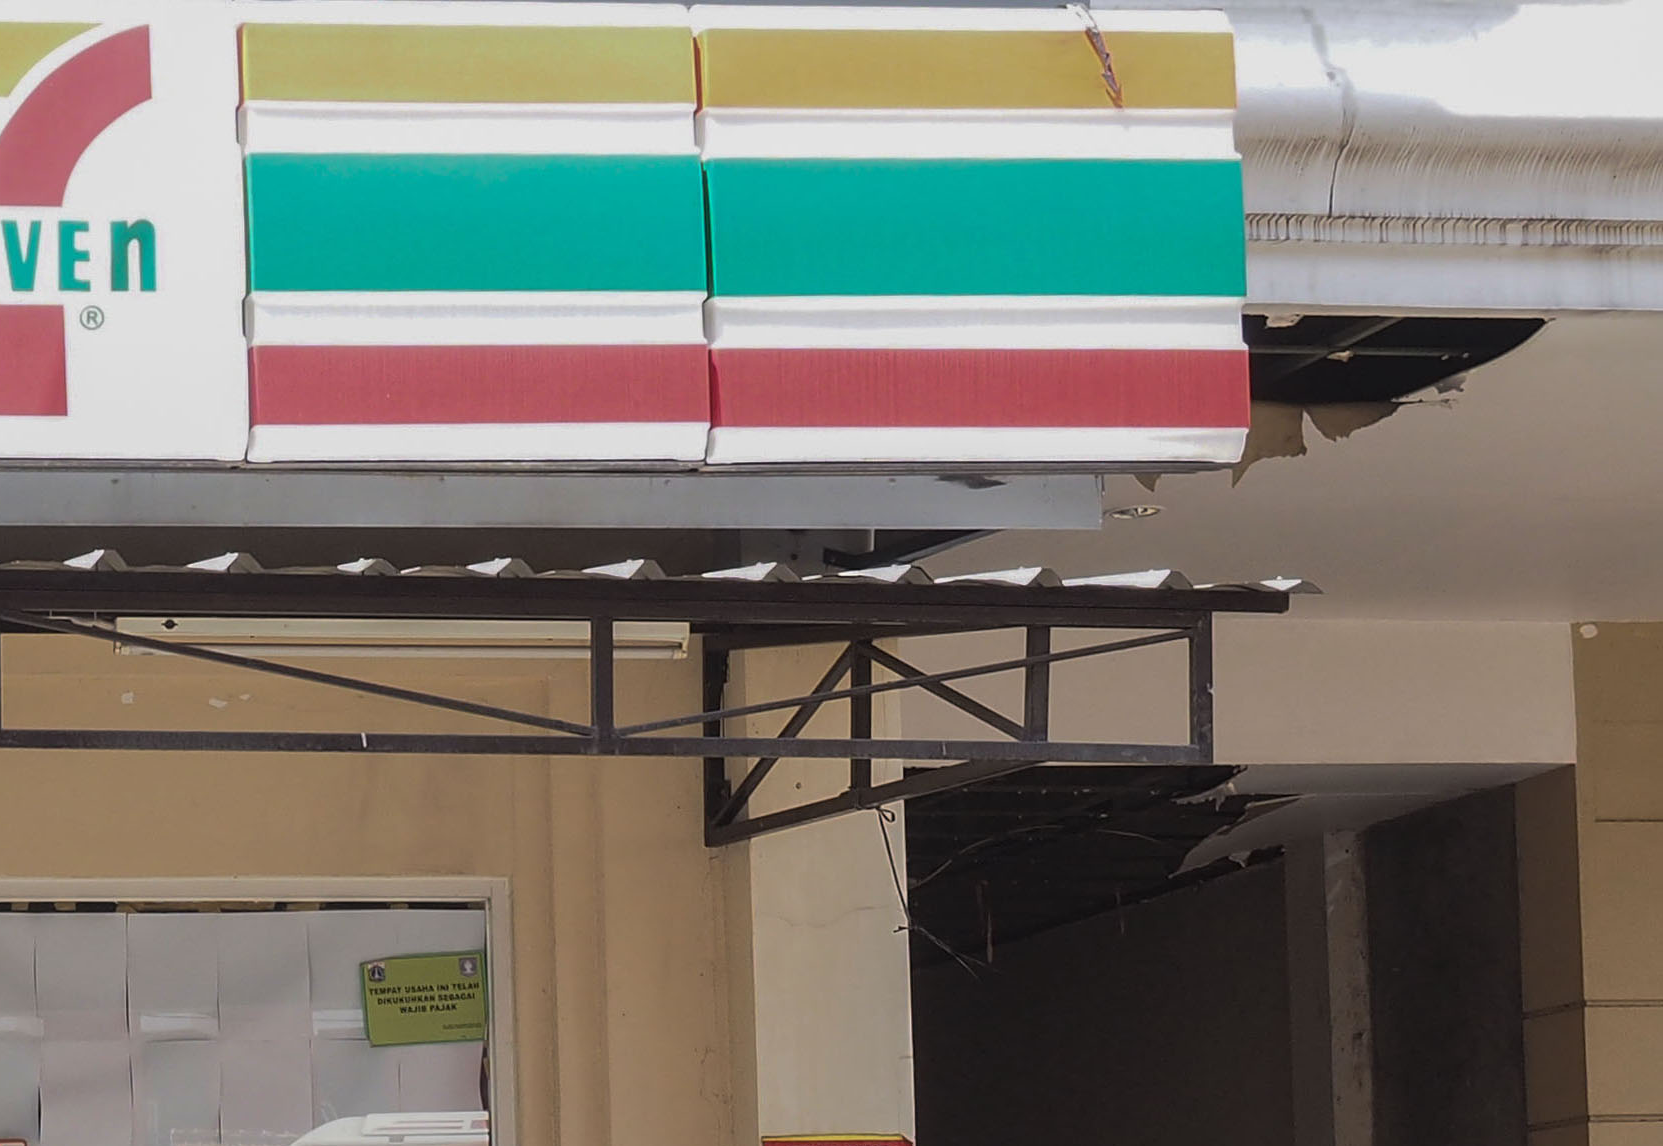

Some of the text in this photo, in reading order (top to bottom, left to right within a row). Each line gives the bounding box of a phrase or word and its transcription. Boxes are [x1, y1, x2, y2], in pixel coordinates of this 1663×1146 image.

[369, 982, 480, 996] TEMPAT USAHA INI TELAH
[400, 1003, 457, 1014] WAJIB PAJAK
